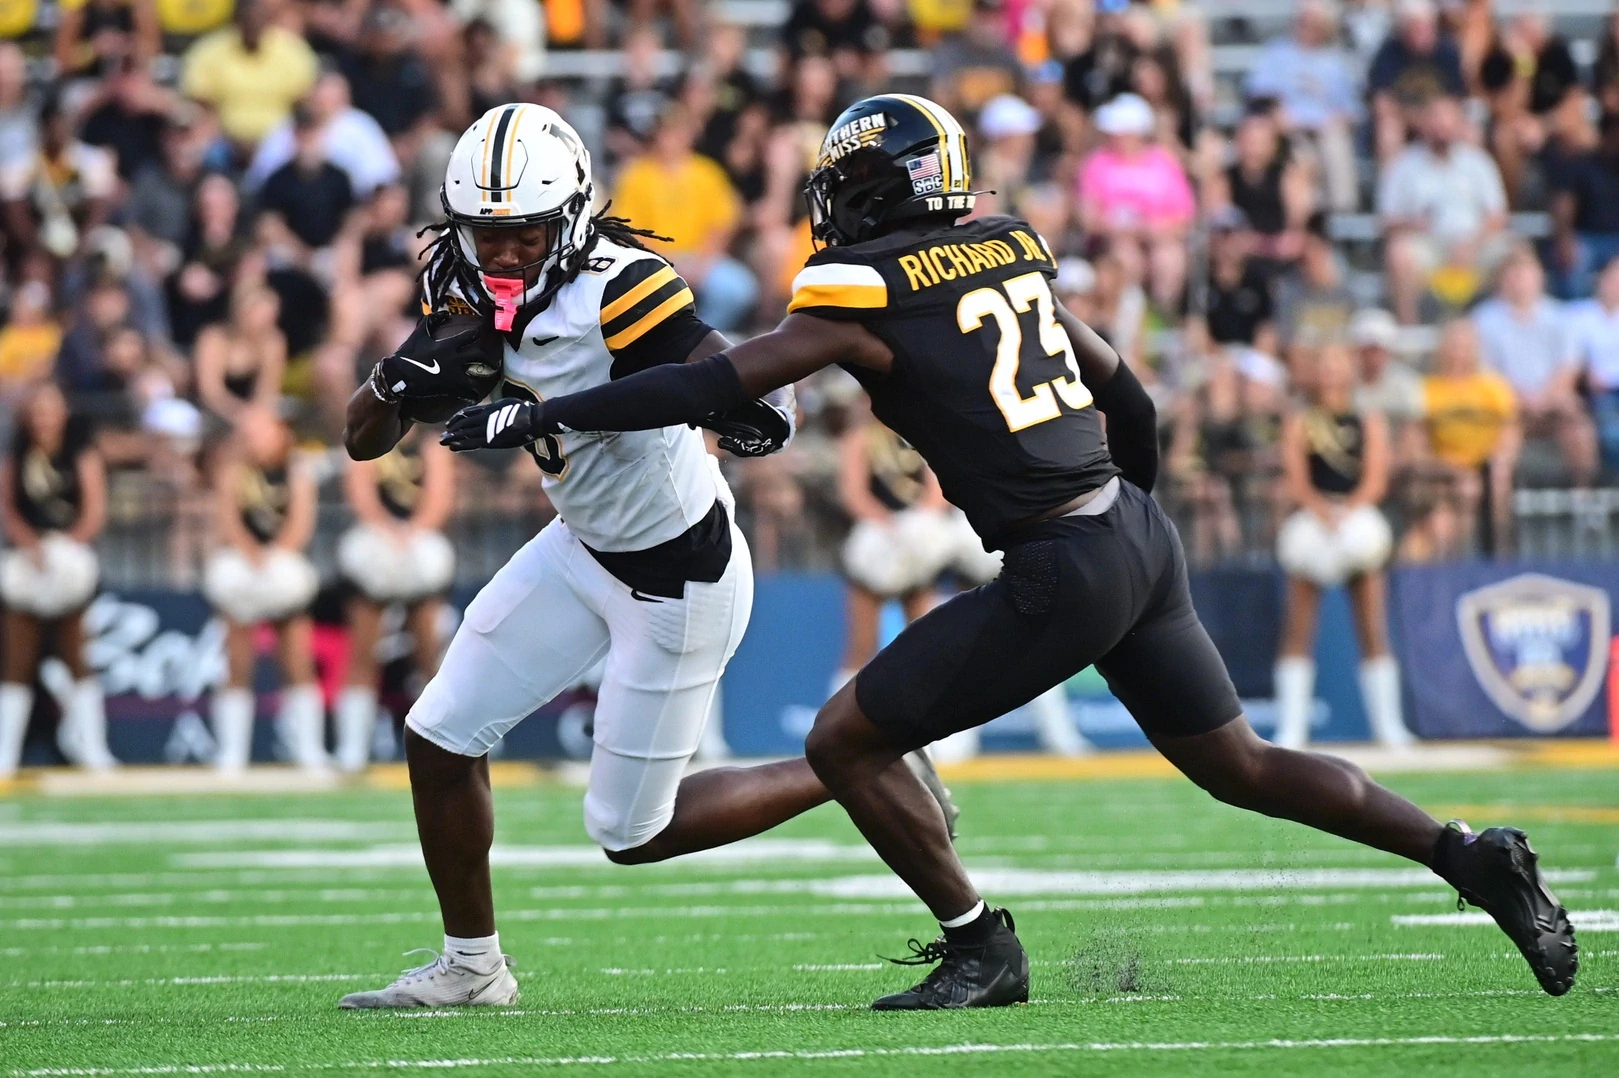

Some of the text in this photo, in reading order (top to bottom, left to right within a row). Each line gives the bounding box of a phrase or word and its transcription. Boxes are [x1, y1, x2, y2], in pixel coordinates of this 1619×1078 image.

[912, 173, 944, 195] SBC
[925, 197, 943, 211] TO
[946, 195, 966, 210] THE
[898, 239, 1017, 292] RICHARD
[956, 271, 1094, 433] 23
